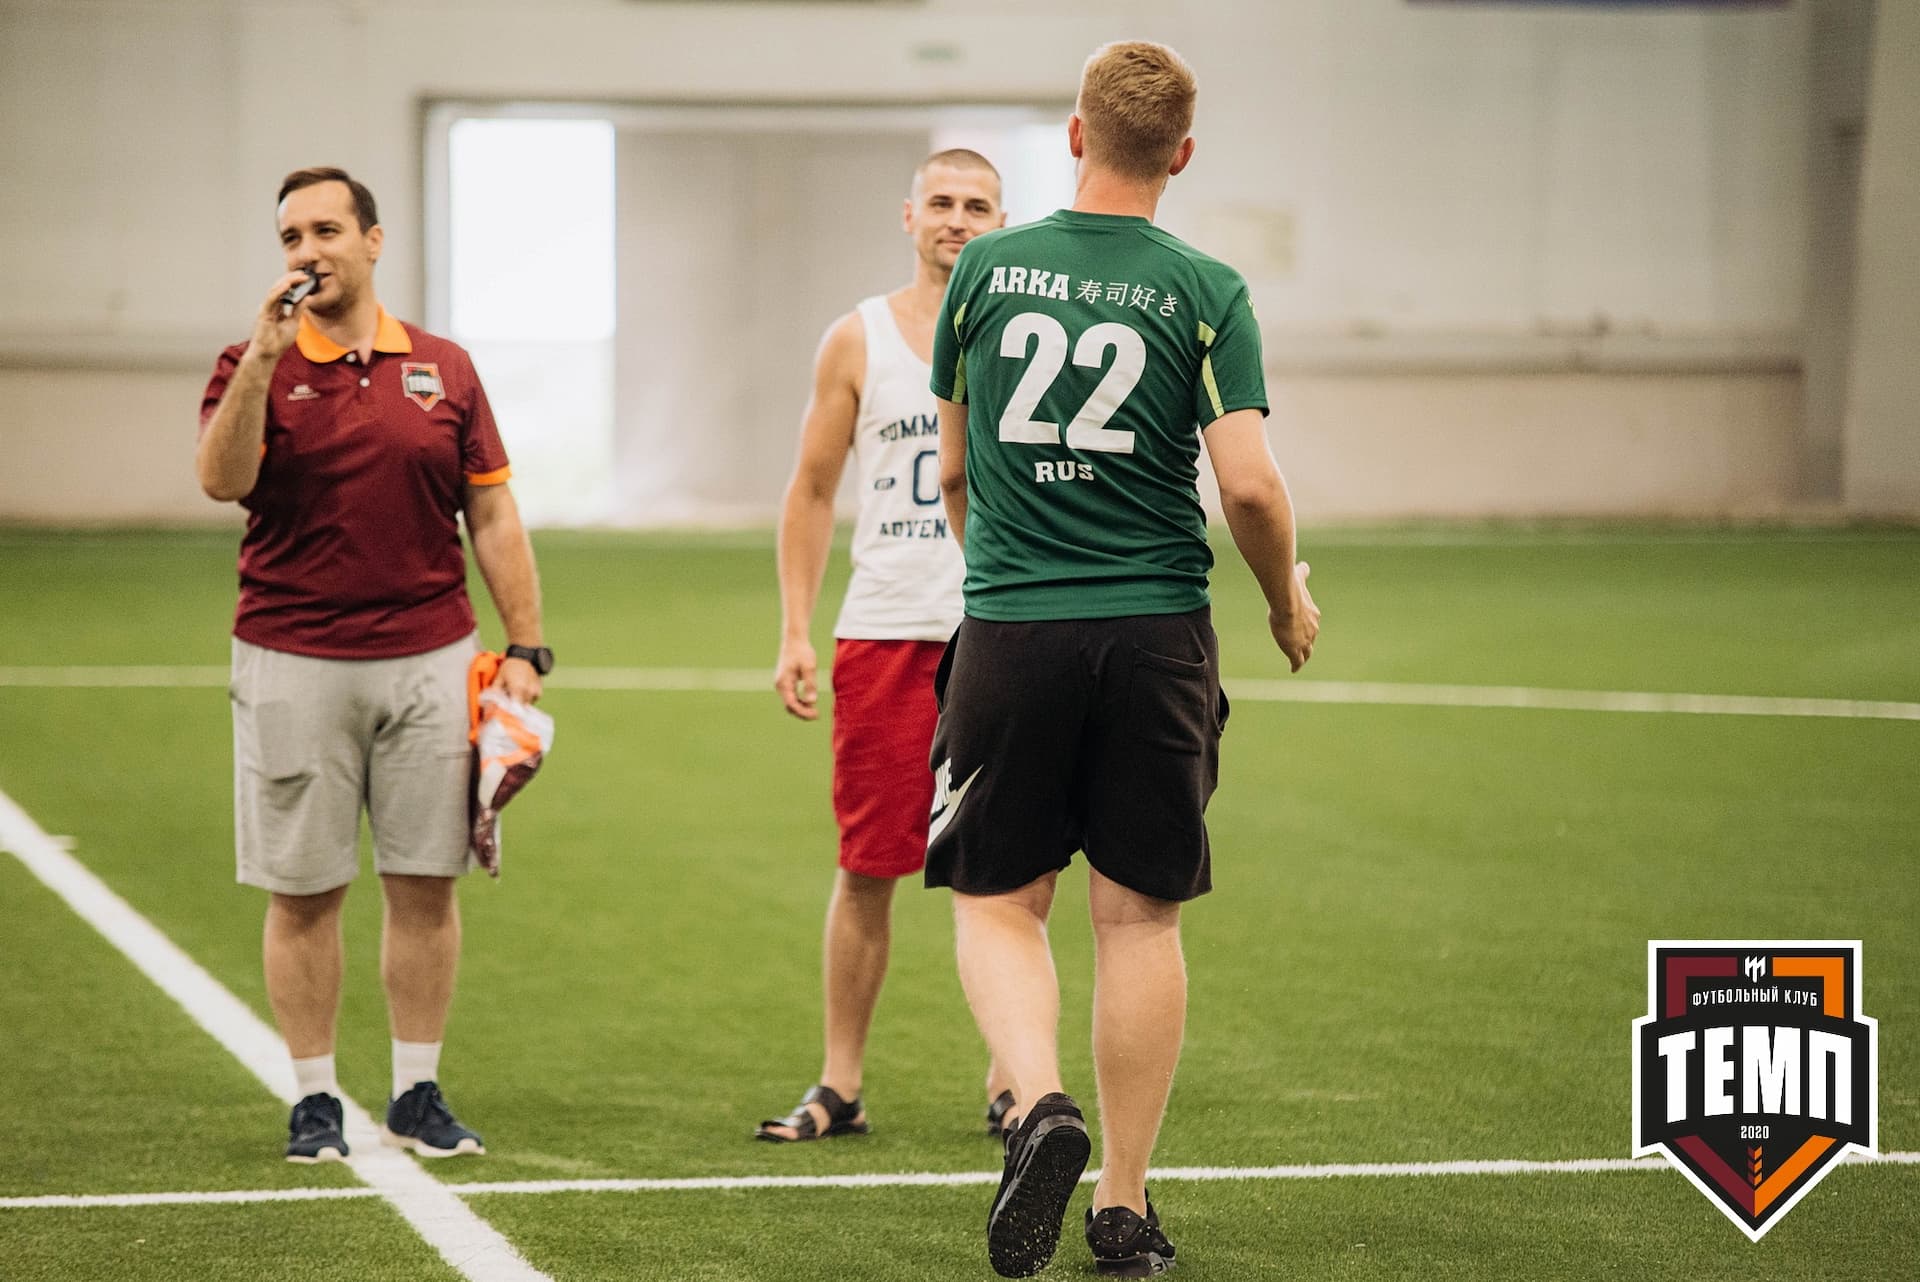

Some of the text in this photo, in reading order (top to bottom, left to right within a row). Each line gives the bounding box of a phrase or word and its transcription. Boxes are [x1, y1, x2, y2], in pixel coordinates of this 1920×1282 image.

[988, 266, 1178, 317] ARKA 寿司好き
[998, 312, 1147, 455] 22
[1034, 461, 1095, 483] RUS
